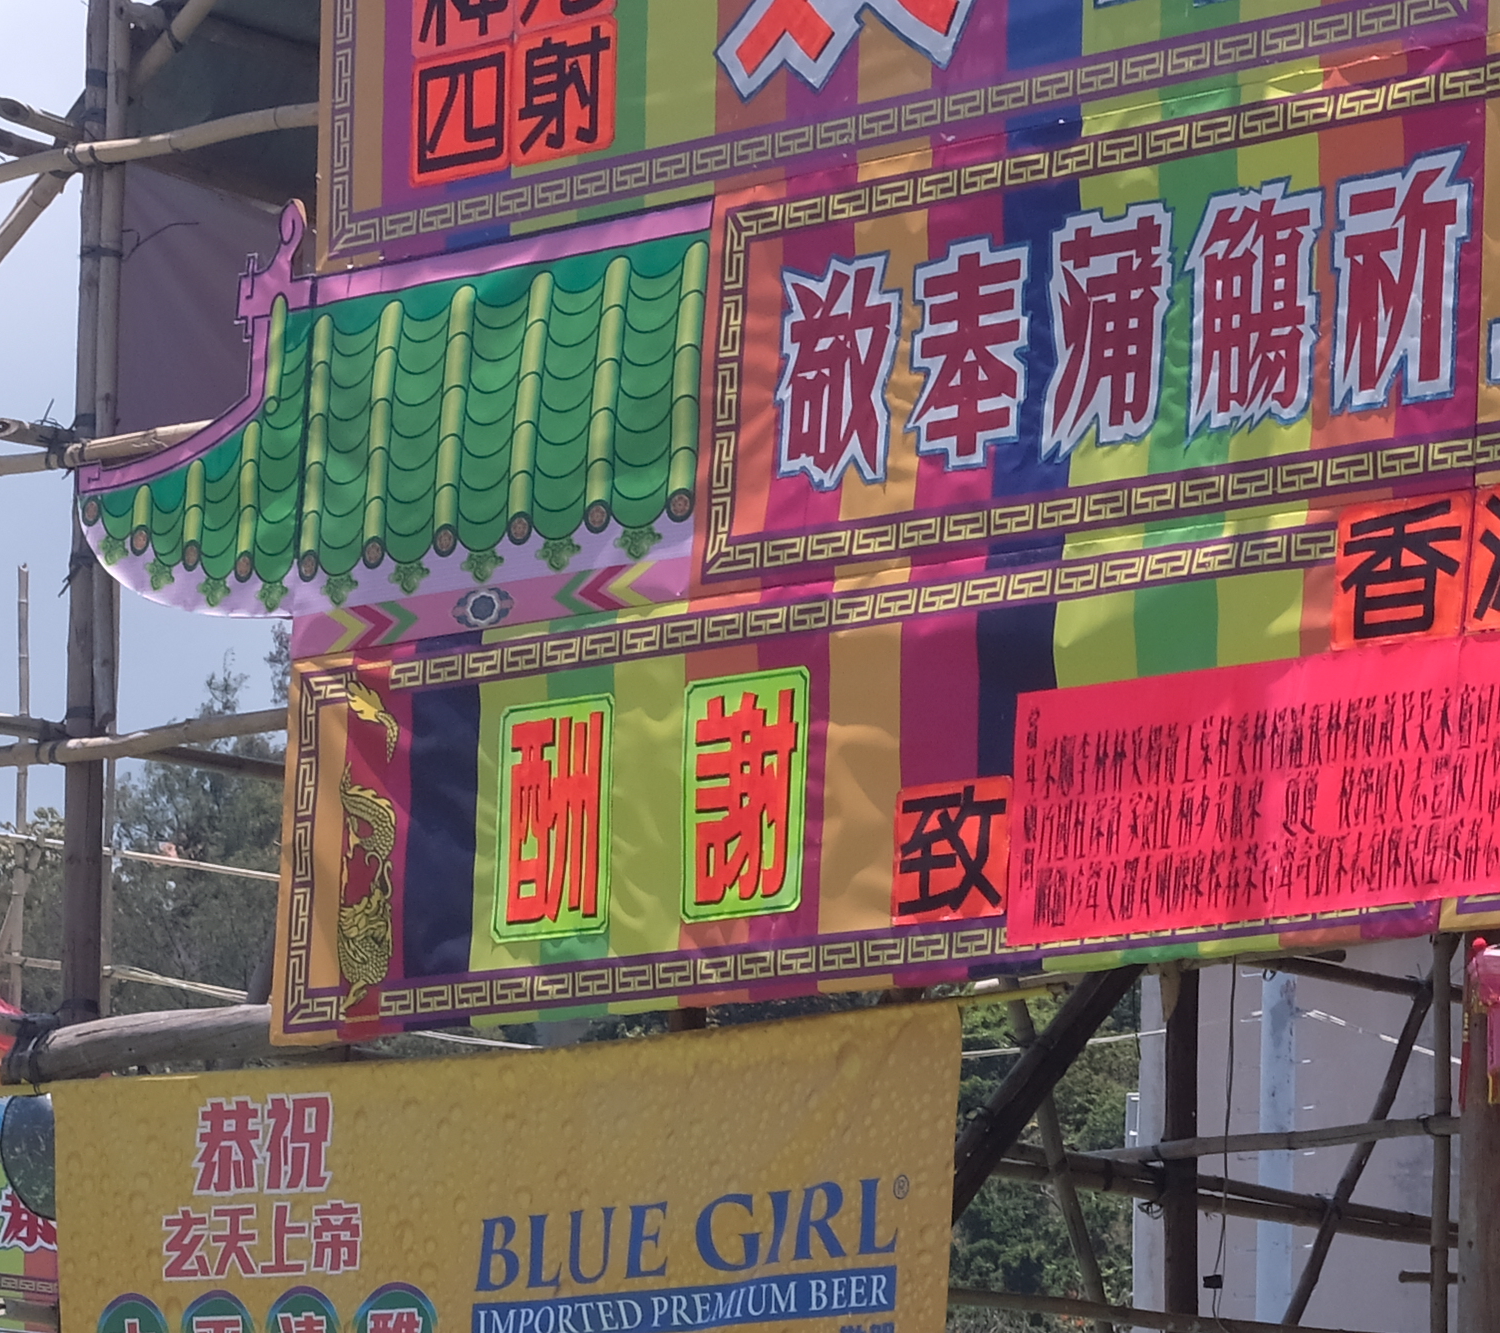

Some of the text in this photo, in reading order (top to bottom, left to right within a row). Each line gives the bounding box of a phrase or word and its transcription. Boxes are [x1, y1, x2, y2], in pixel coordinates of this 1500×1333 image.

[507, 689, 798, 926] 酬謝
[900, 785, 1006, 917] 致
[192, 1091, 337, 1197] 恭祝
[161, 1201, 364, 1283] 玄天上帝
[473, 1178, 896, 1293] BLUE GIRL
[651, 1285, 798, 1332] PREMIUM
[807, 1275, 890, 1315] BEER
